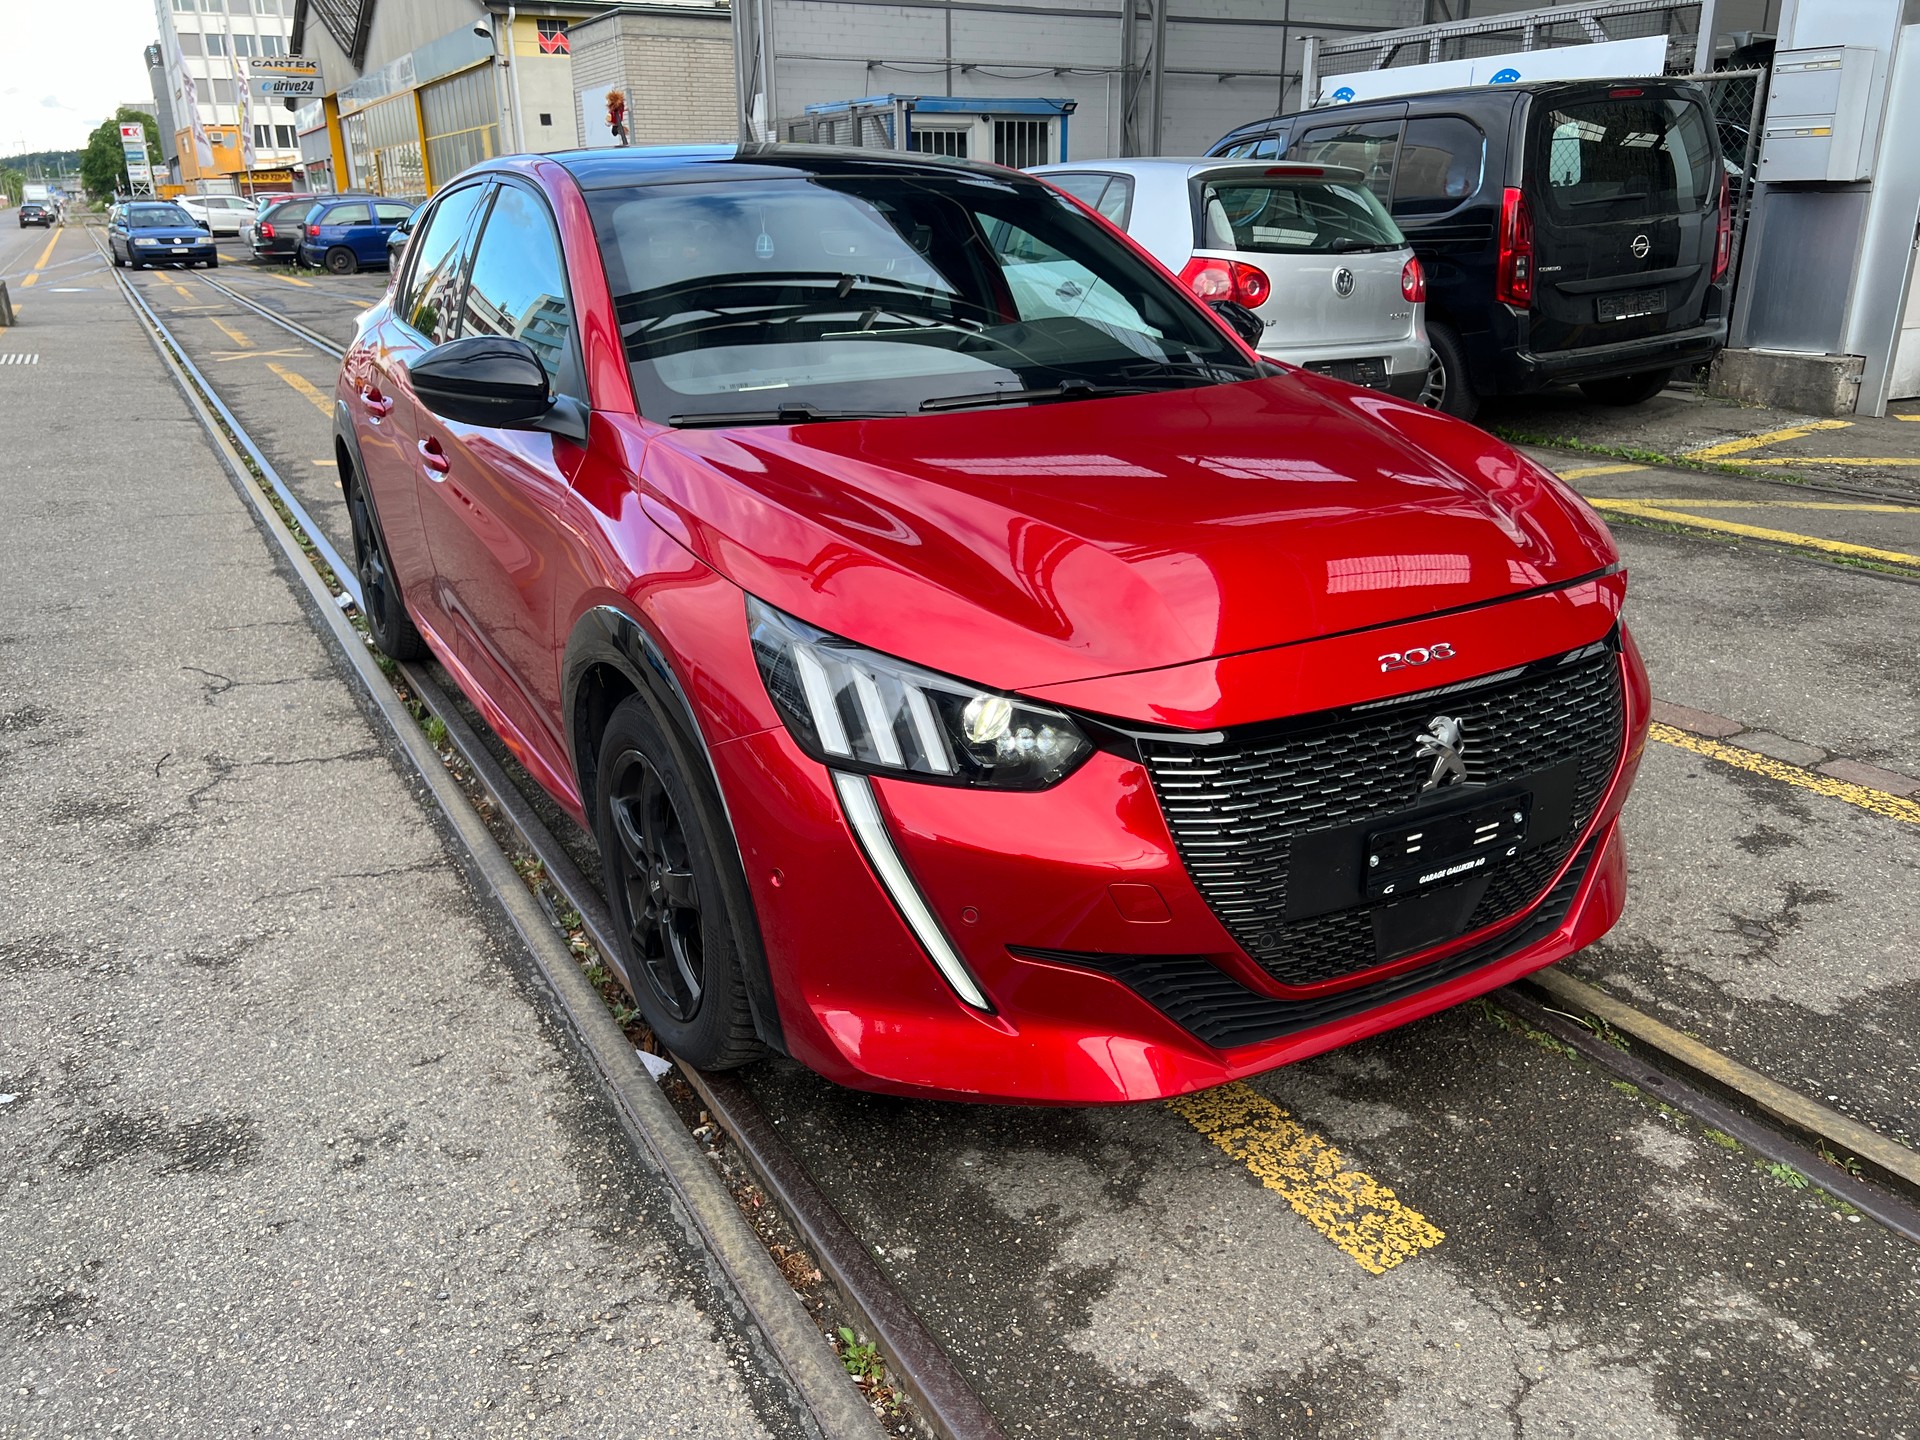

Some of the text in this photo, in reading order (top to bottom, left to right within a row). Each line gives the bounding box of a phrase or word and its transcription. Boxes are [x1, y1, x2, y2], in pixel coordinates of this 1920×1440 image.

[251, 60, 317, 68] CARTEK
[1378, 642, 1456, 673] 208
[1419, 857, 1486, 884] GARAGE GALLIKER AG
